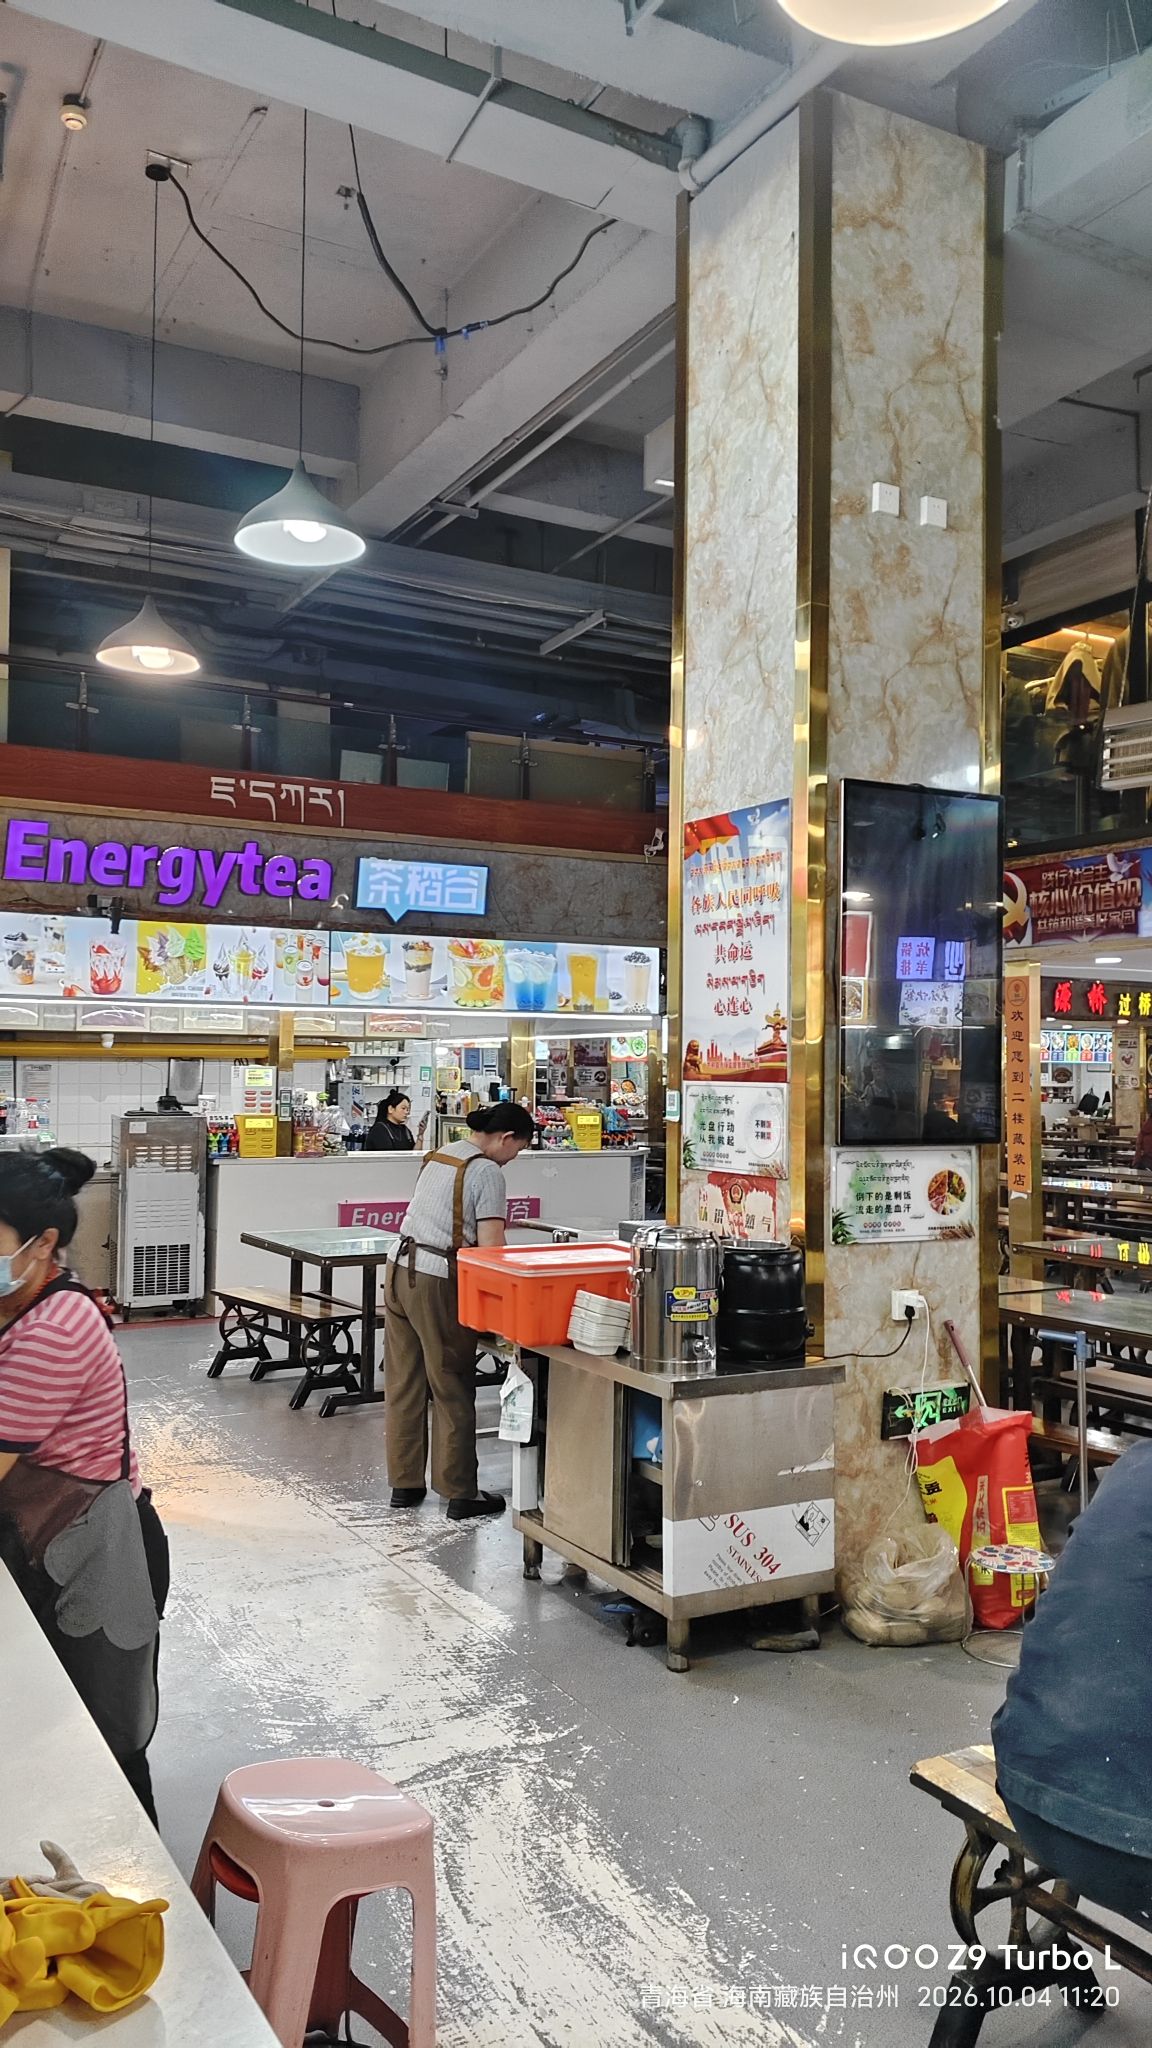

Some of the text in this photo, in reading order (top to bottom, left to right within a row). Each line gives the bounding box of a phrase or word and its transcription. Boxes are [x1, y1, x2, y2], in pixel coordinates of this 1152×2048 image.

[3, 818, 334, 909] Energytea
[367, 860, 480, 910] 茶稻谷
[691, 882, 781, 915] 各族人民同呼吸
[1029, 877, 1142, 917] 核心价值观
[714, 940, 754, 964] 共命运
[714, 996, 753, 1016] 心连心
[1011, 1010, 1026, 1187] 欢迎您到二楼藏装店
[699, 1120, 735, 1133] 光盘行动
[699, 1133, 735, 1147] 从我做起
[856, 1191, 912, 1202] 倒下的是剩饭
[856, 1203, 912, 1215] 流走的是血汗
[724, 1514, 782, 1575] SUS 304
